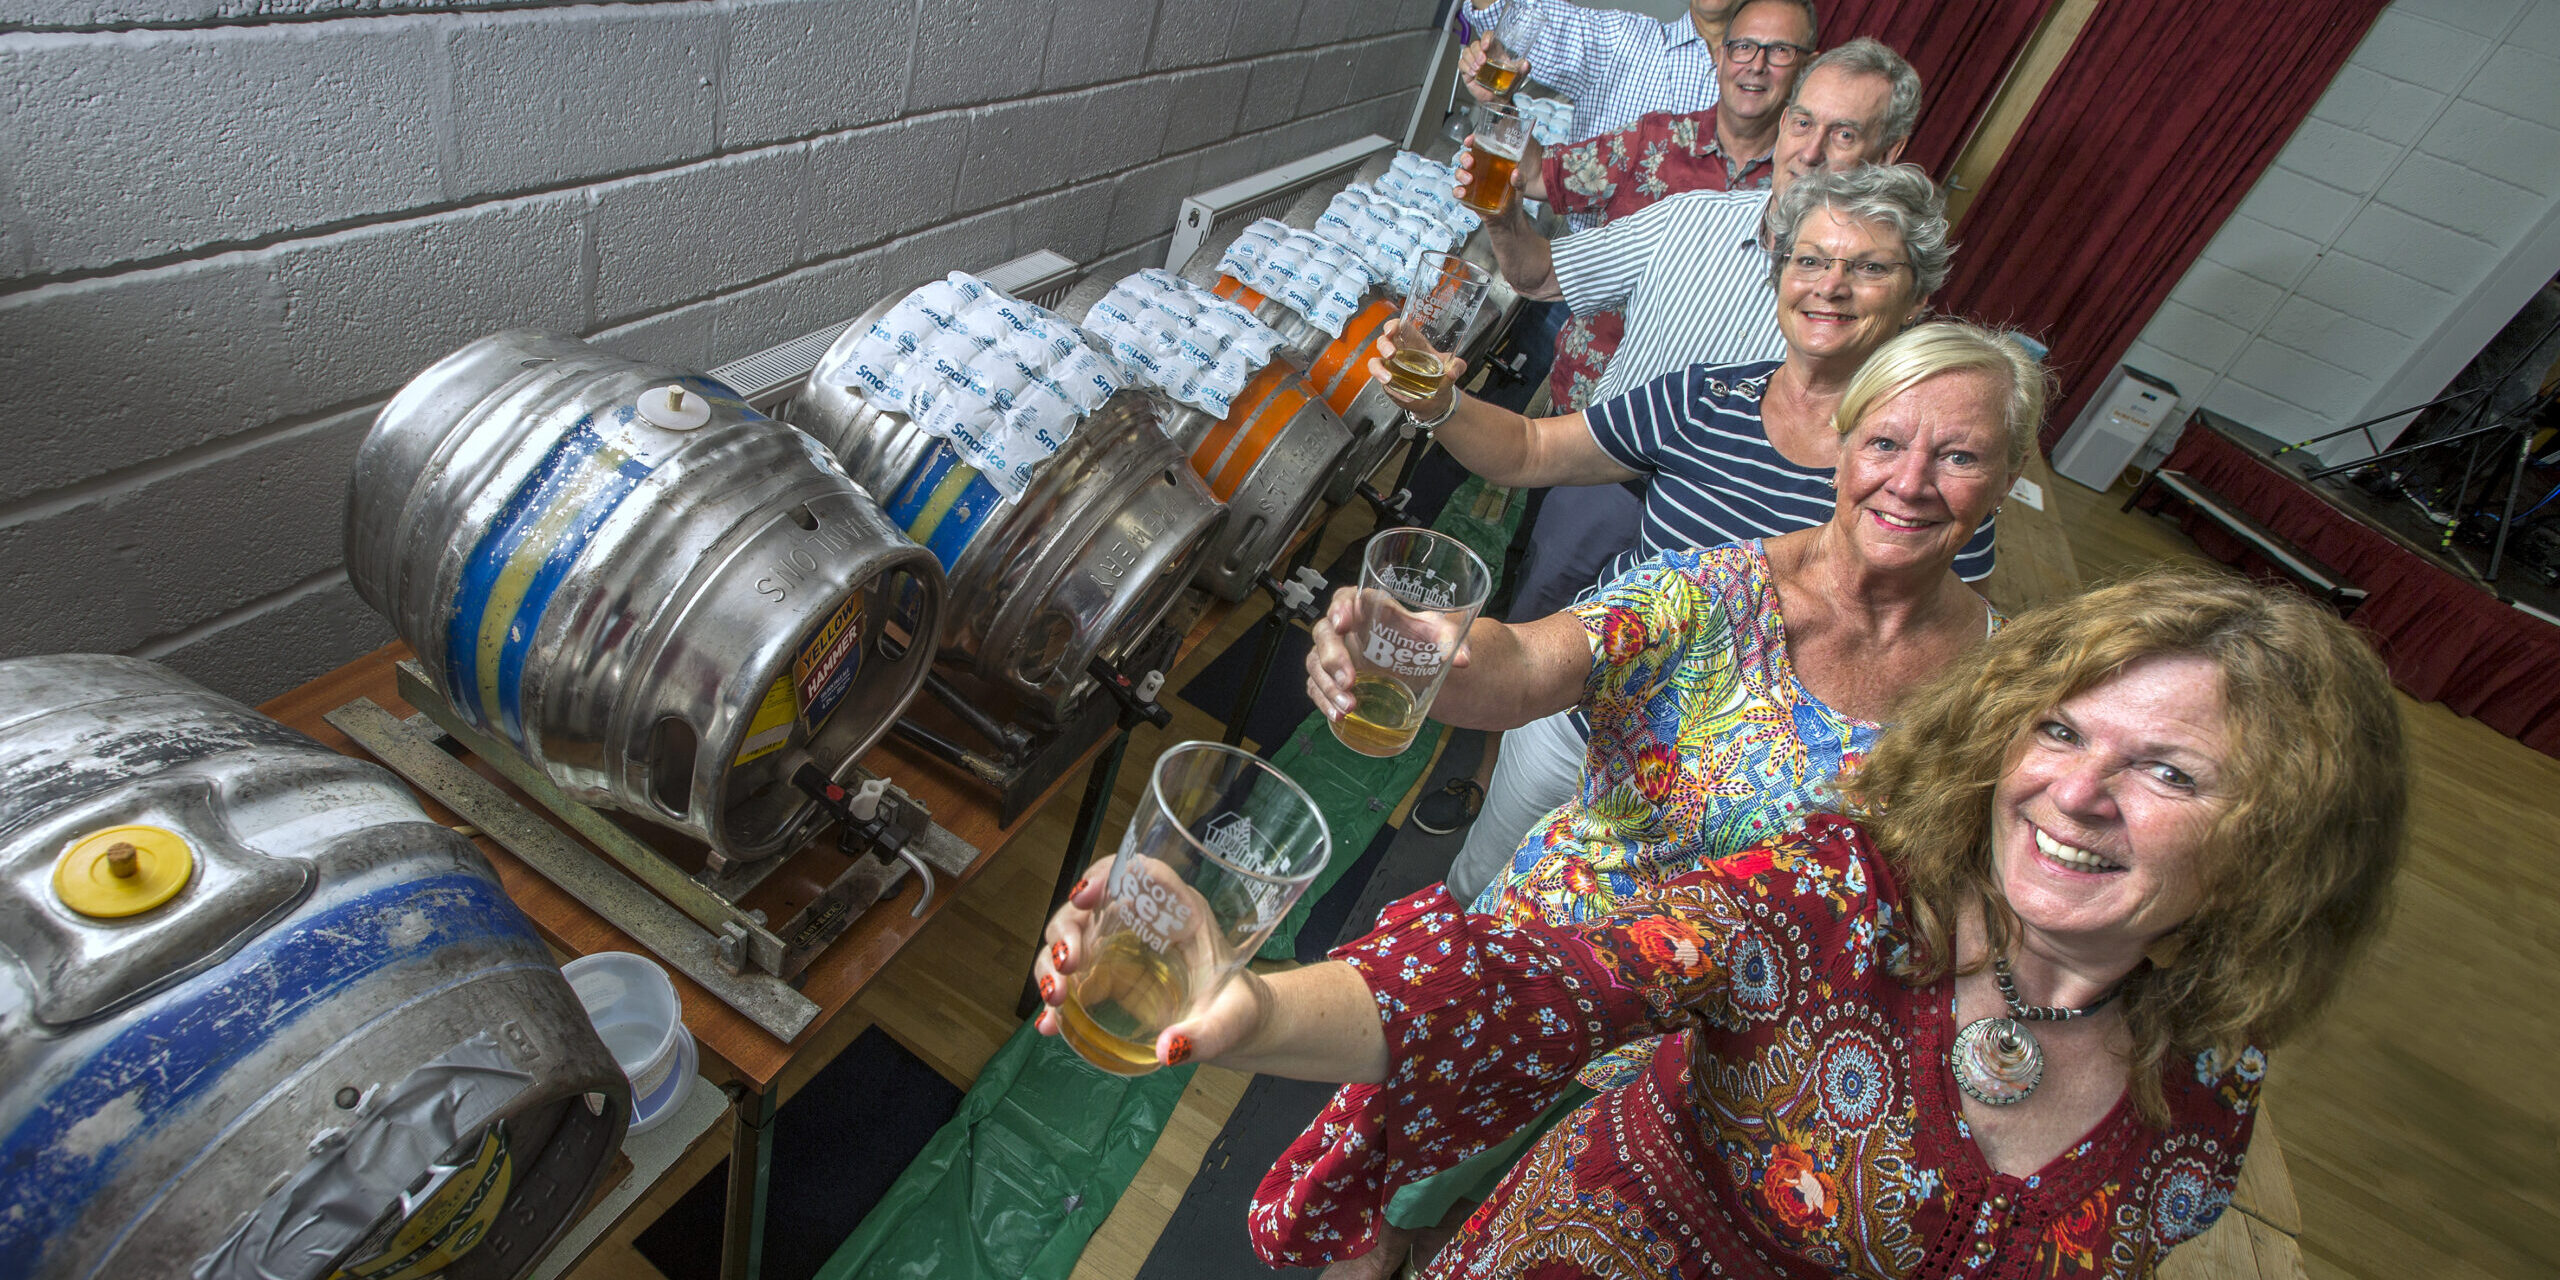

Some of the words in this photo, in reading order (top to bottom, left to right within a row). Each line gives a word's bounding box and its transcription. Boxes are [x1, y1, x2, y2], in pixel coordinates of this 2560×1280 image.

[803, 599, 854, 669] YELLOW
[1363, 630, 1448, 669] Beer
[807, 624, 857, 699] HAMMER
[1392, 661, 1441, 677] Festival
